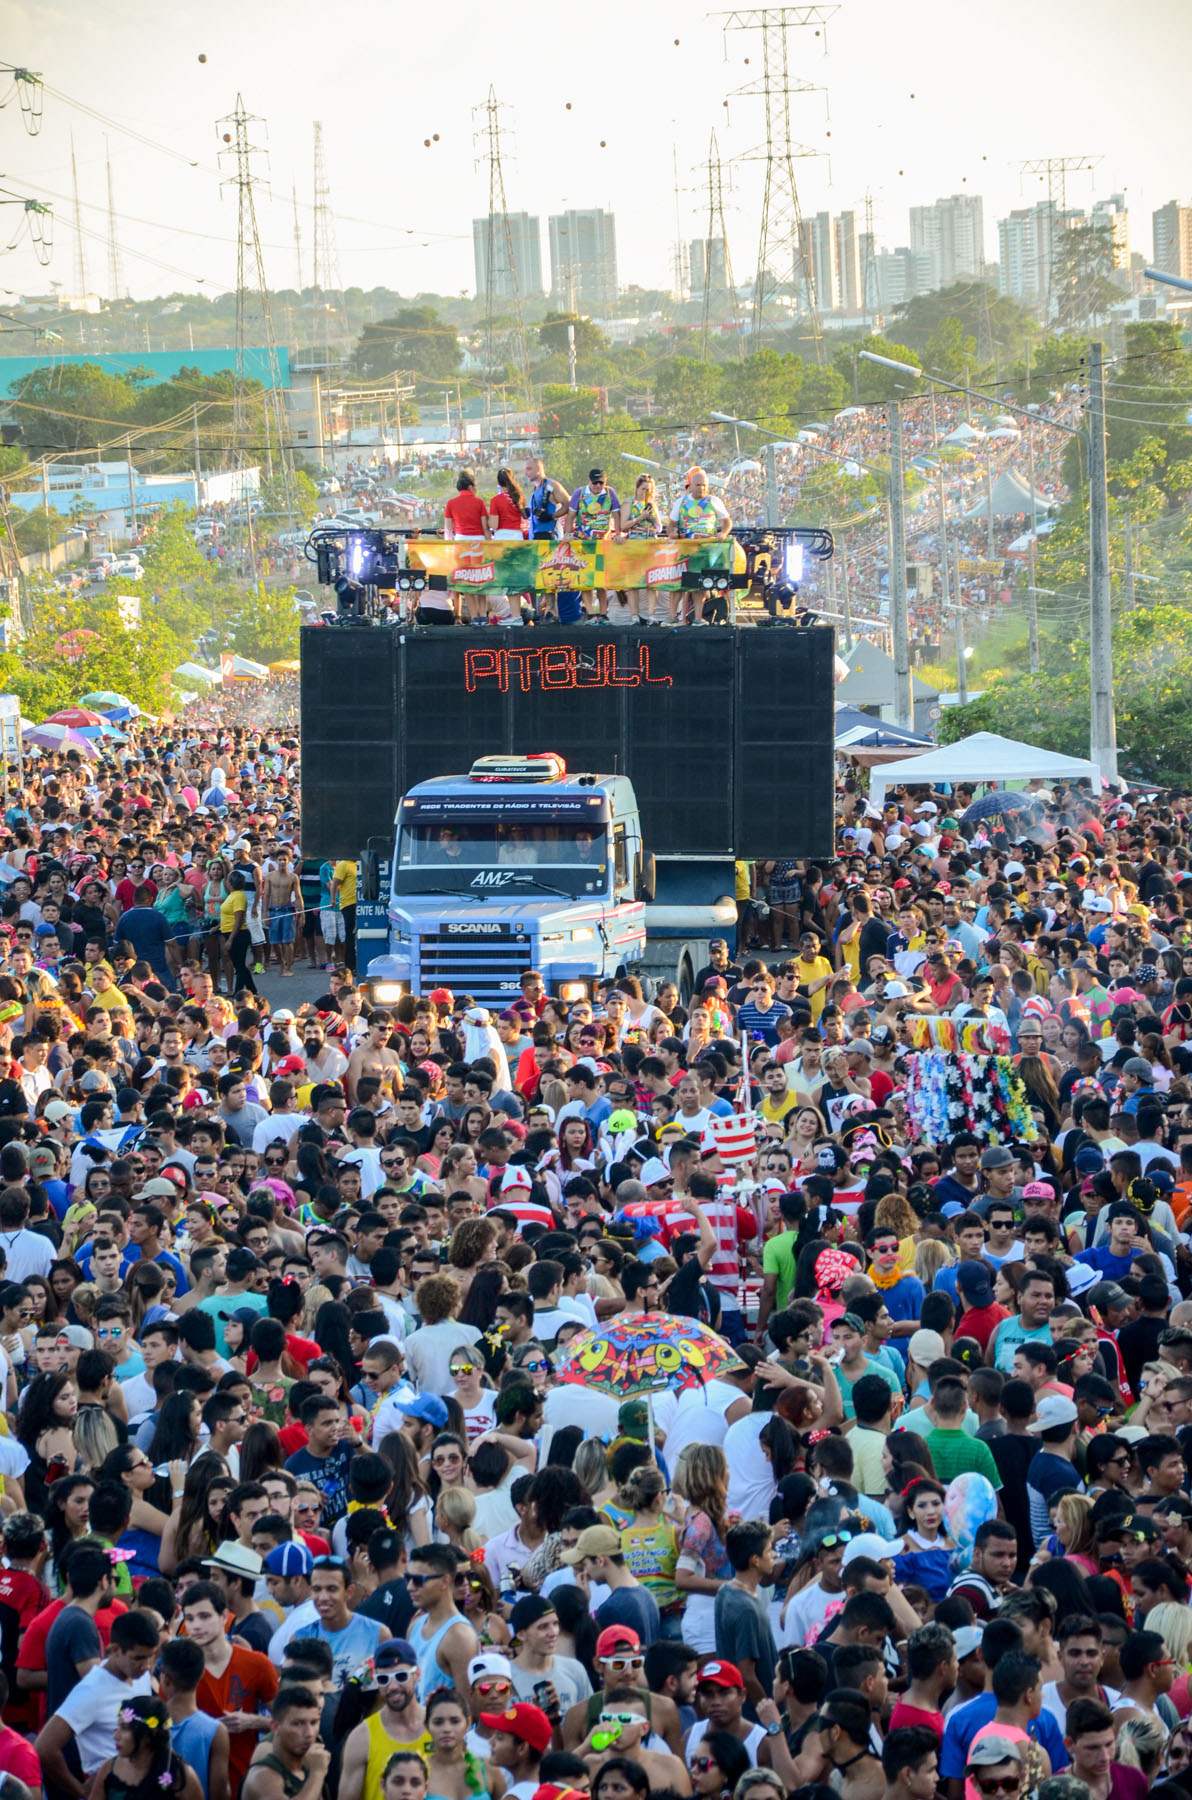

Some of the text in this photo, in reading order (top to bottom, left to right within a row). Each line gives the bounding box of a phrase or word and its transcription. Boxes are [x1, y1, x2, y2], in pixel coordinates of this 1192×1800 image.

[454, 566, 493, 582] BRAHMA
[648, 562, 687, 583] BRAHMA
[464, 644, 673, 692] PITBULL
[471, 871, 514, 885] AMZ
[448, 923, 502, 933] SCANIA
